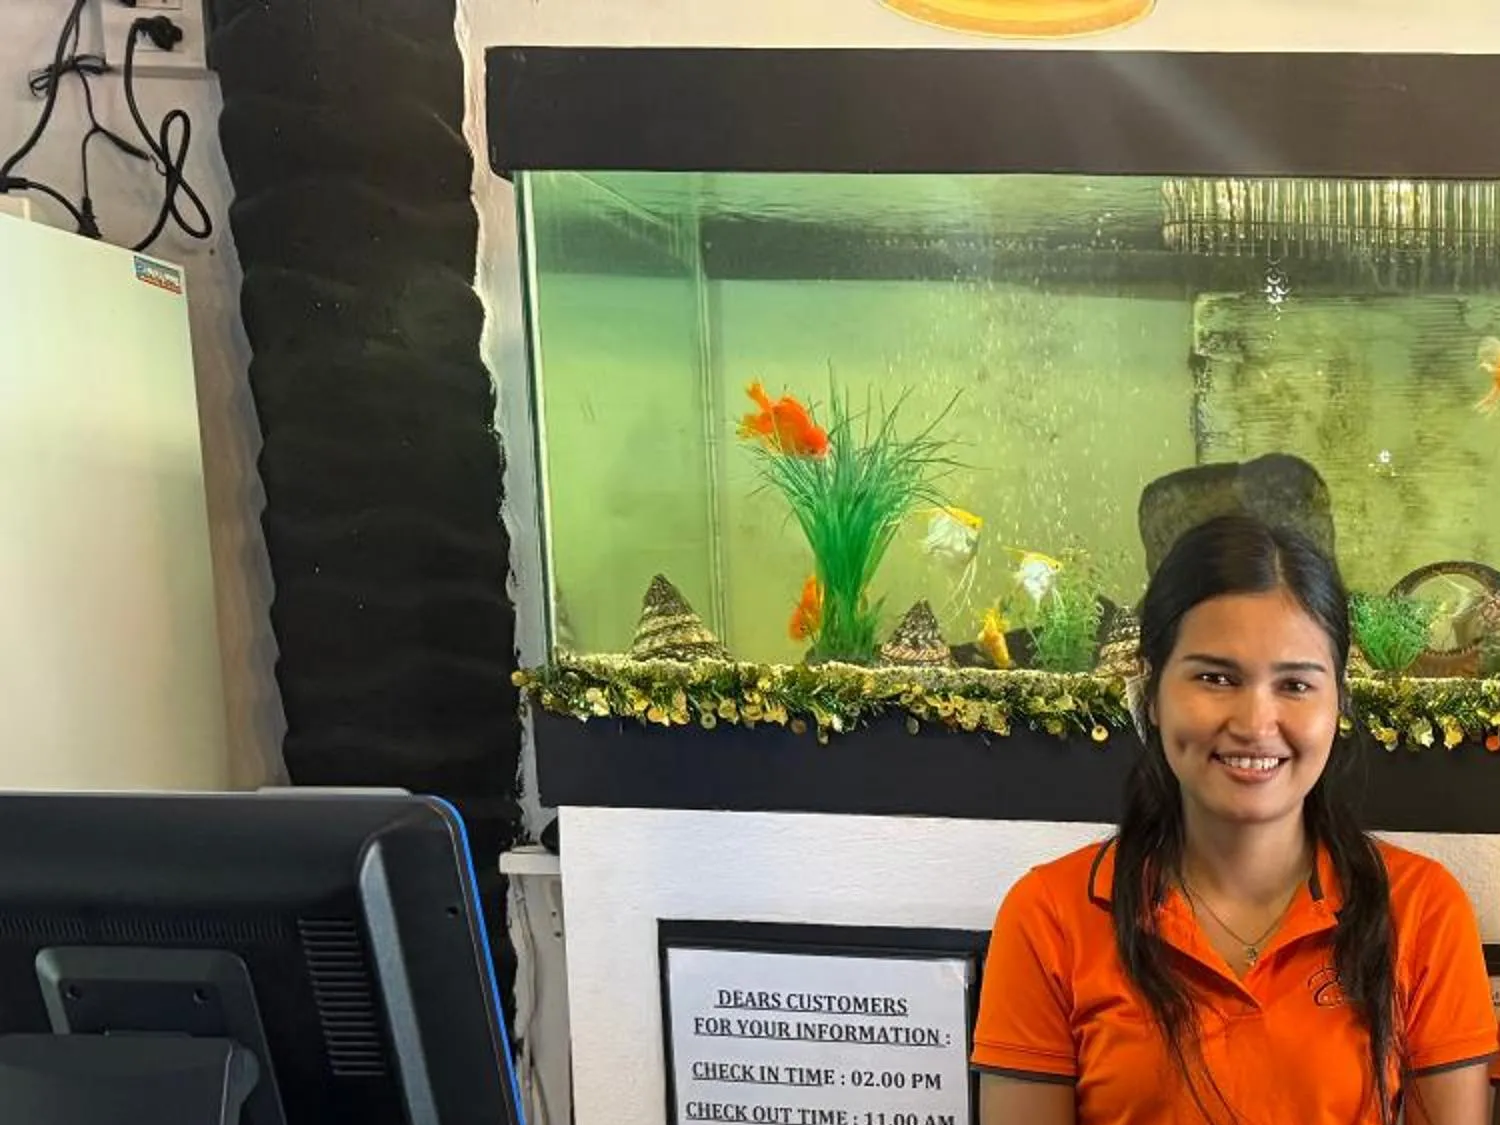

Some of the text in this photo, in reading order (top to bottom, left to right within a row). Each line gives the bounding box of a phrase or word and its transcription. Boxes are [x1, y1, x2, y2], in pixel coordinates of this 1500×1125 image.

[718, 990, 908, 1015] DEARS CUSTOMERS
[694, 1018, 731, 1036] FOR
[737, 1020, 790, 1038] YOUR
[796, 1023, 940, 1044] INFORMATION
[692, 1062, 754, 1081] CHECK
[760, 1065, 779, 1082] IN
[785, 1067, 835, 1085] TIME
[851, 1070, 905, 1089] 02.00
[911, 1073, 942, 1090] PM
[686, 1102, 747, 1121] CHECK
[752, 1106, 792, 1123] OUT
[798, 1108, 848, 1125] TIME
